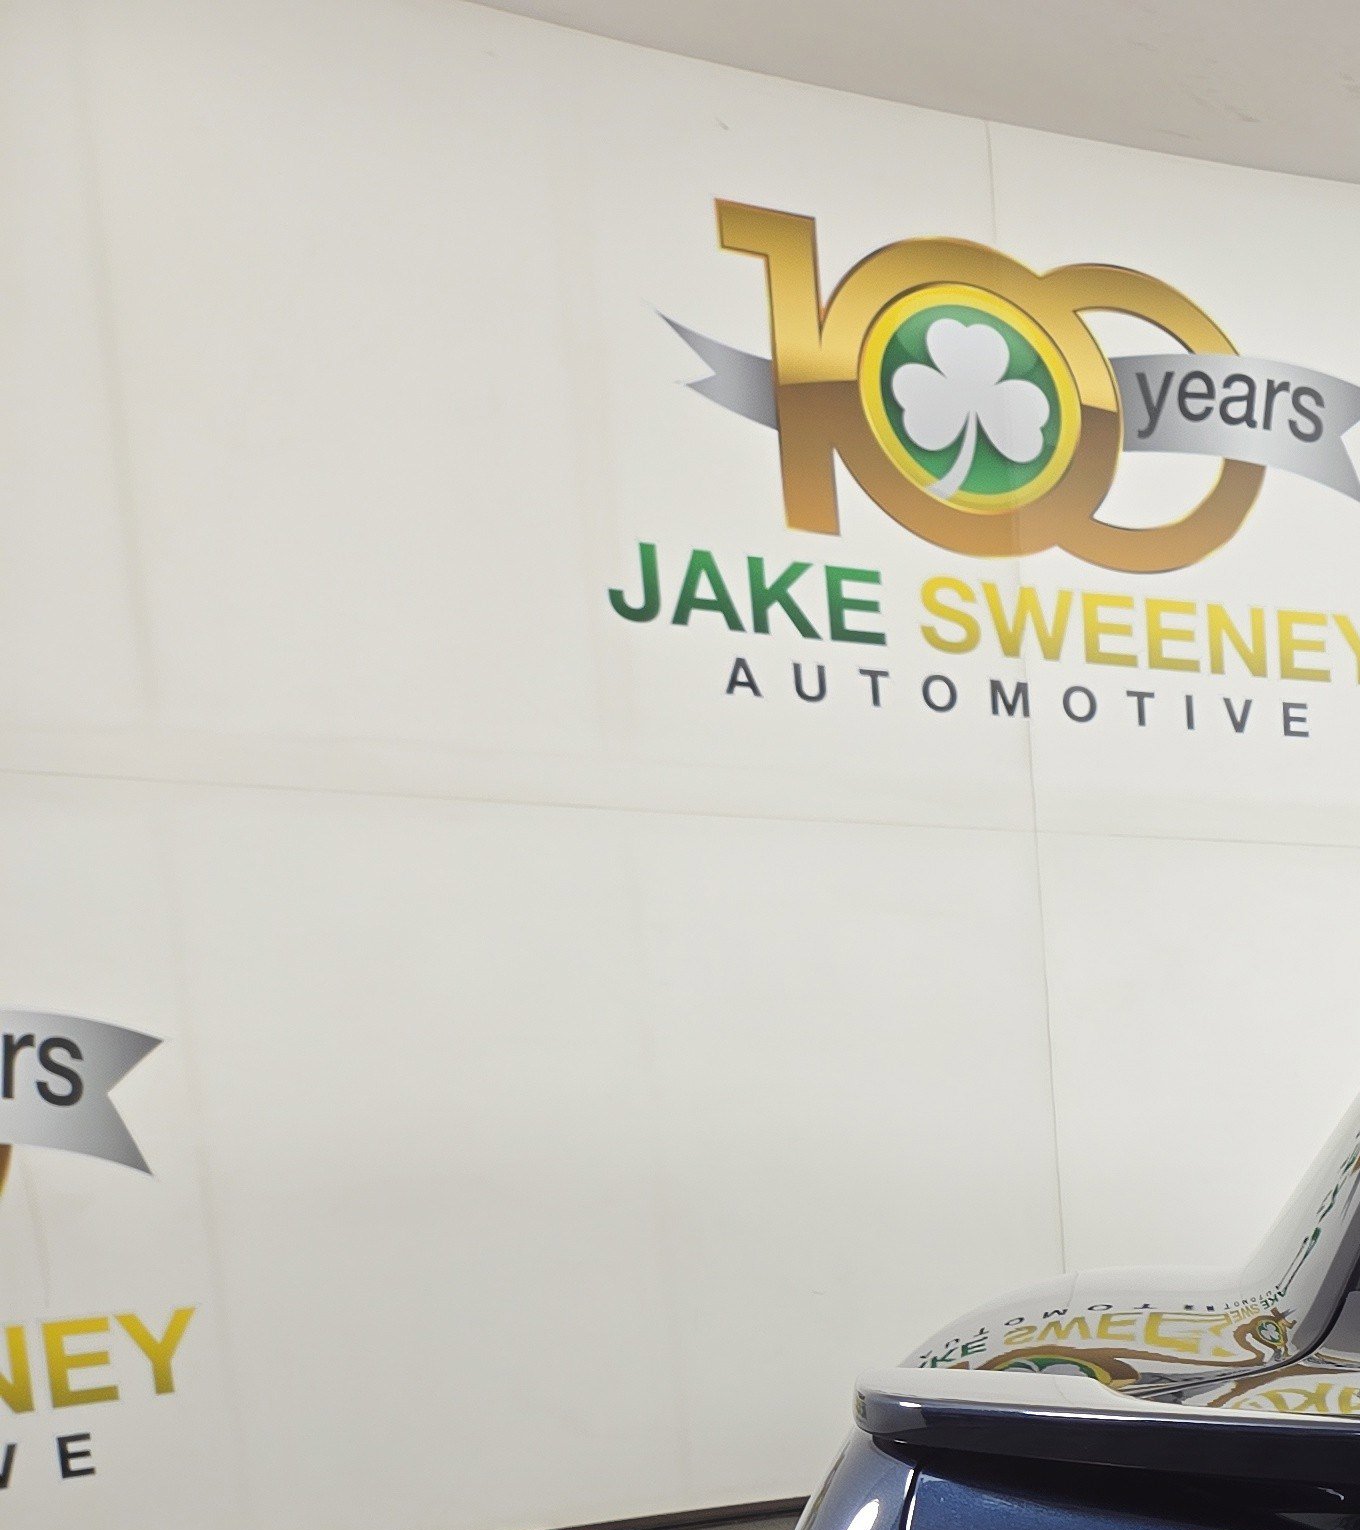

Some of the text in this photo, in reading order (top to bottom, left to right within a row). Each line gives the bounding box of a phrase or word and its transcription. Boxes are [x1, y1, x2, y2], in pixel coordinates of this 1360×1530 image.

[714, 198, 1327, 574] 100 years
[608, 541, 888, 647] JAKE
[725, 657, 1311, 739] AUTOMOTIVE
